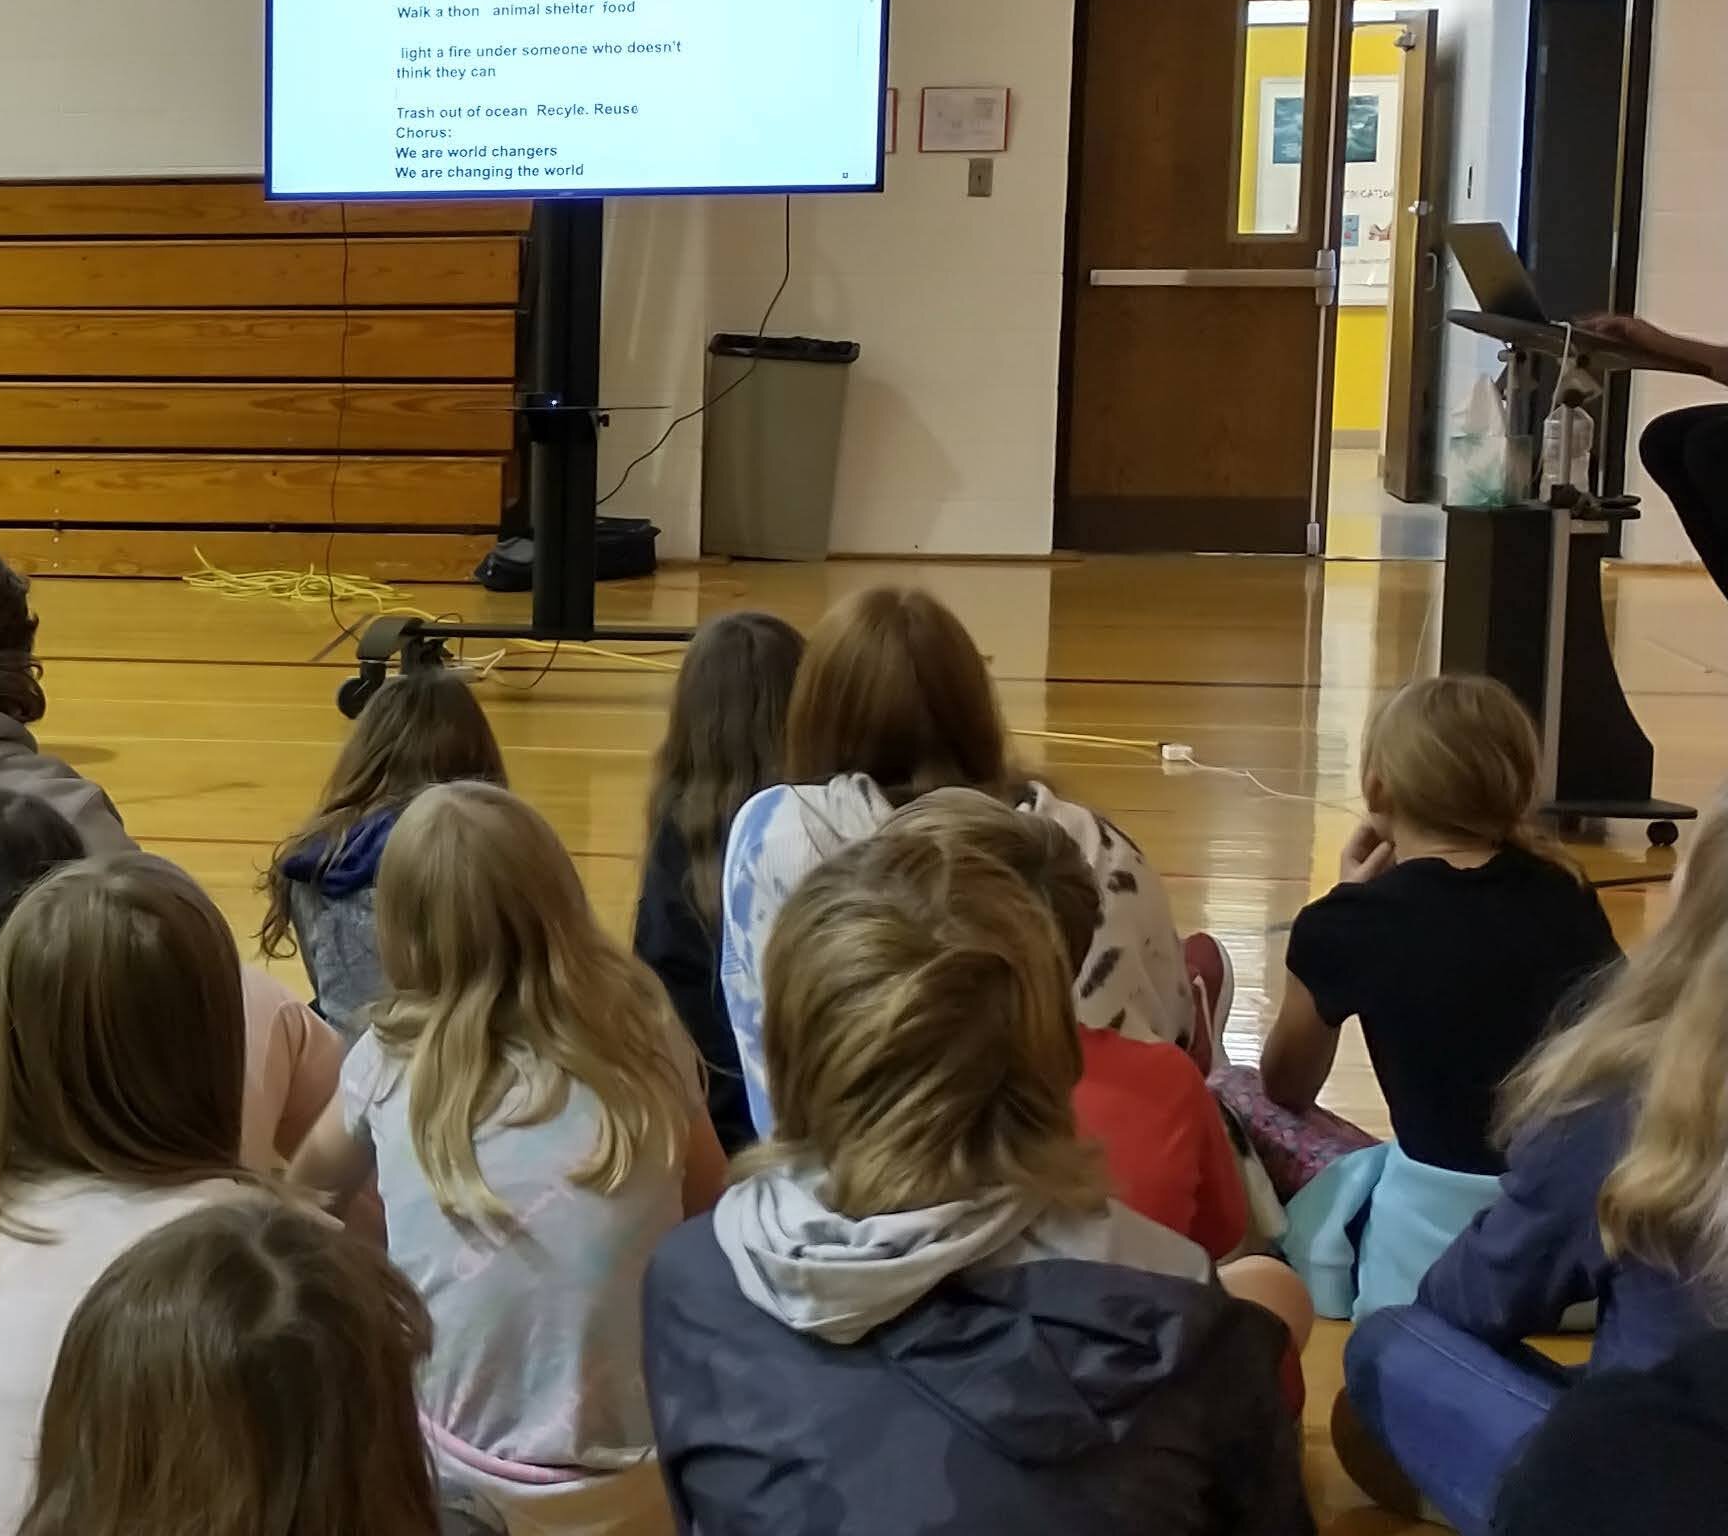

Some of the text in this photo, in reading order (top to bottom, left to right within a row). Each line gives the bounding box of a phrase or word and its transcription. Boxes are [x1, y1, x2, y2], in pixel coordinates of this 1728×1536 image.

[398, 1, 635, 18] Walk a thon animal shelter food
[402, 41, 680, 62] light a fire under someone who doesn't
[397, 66, 495, 80] think they can
[397, 107, 434, 119] Trash
[440, 107, 462, 118] out
[467, 106, 481, 117] of
[486, 108, 527, 117] ocean
[595, 104, 638, 115] Reuse
[396, 127, 451, 138] Chorus:
[395, 145, 557, 159] We are world changers
[395, 164, 584, 180] We are changing the world
